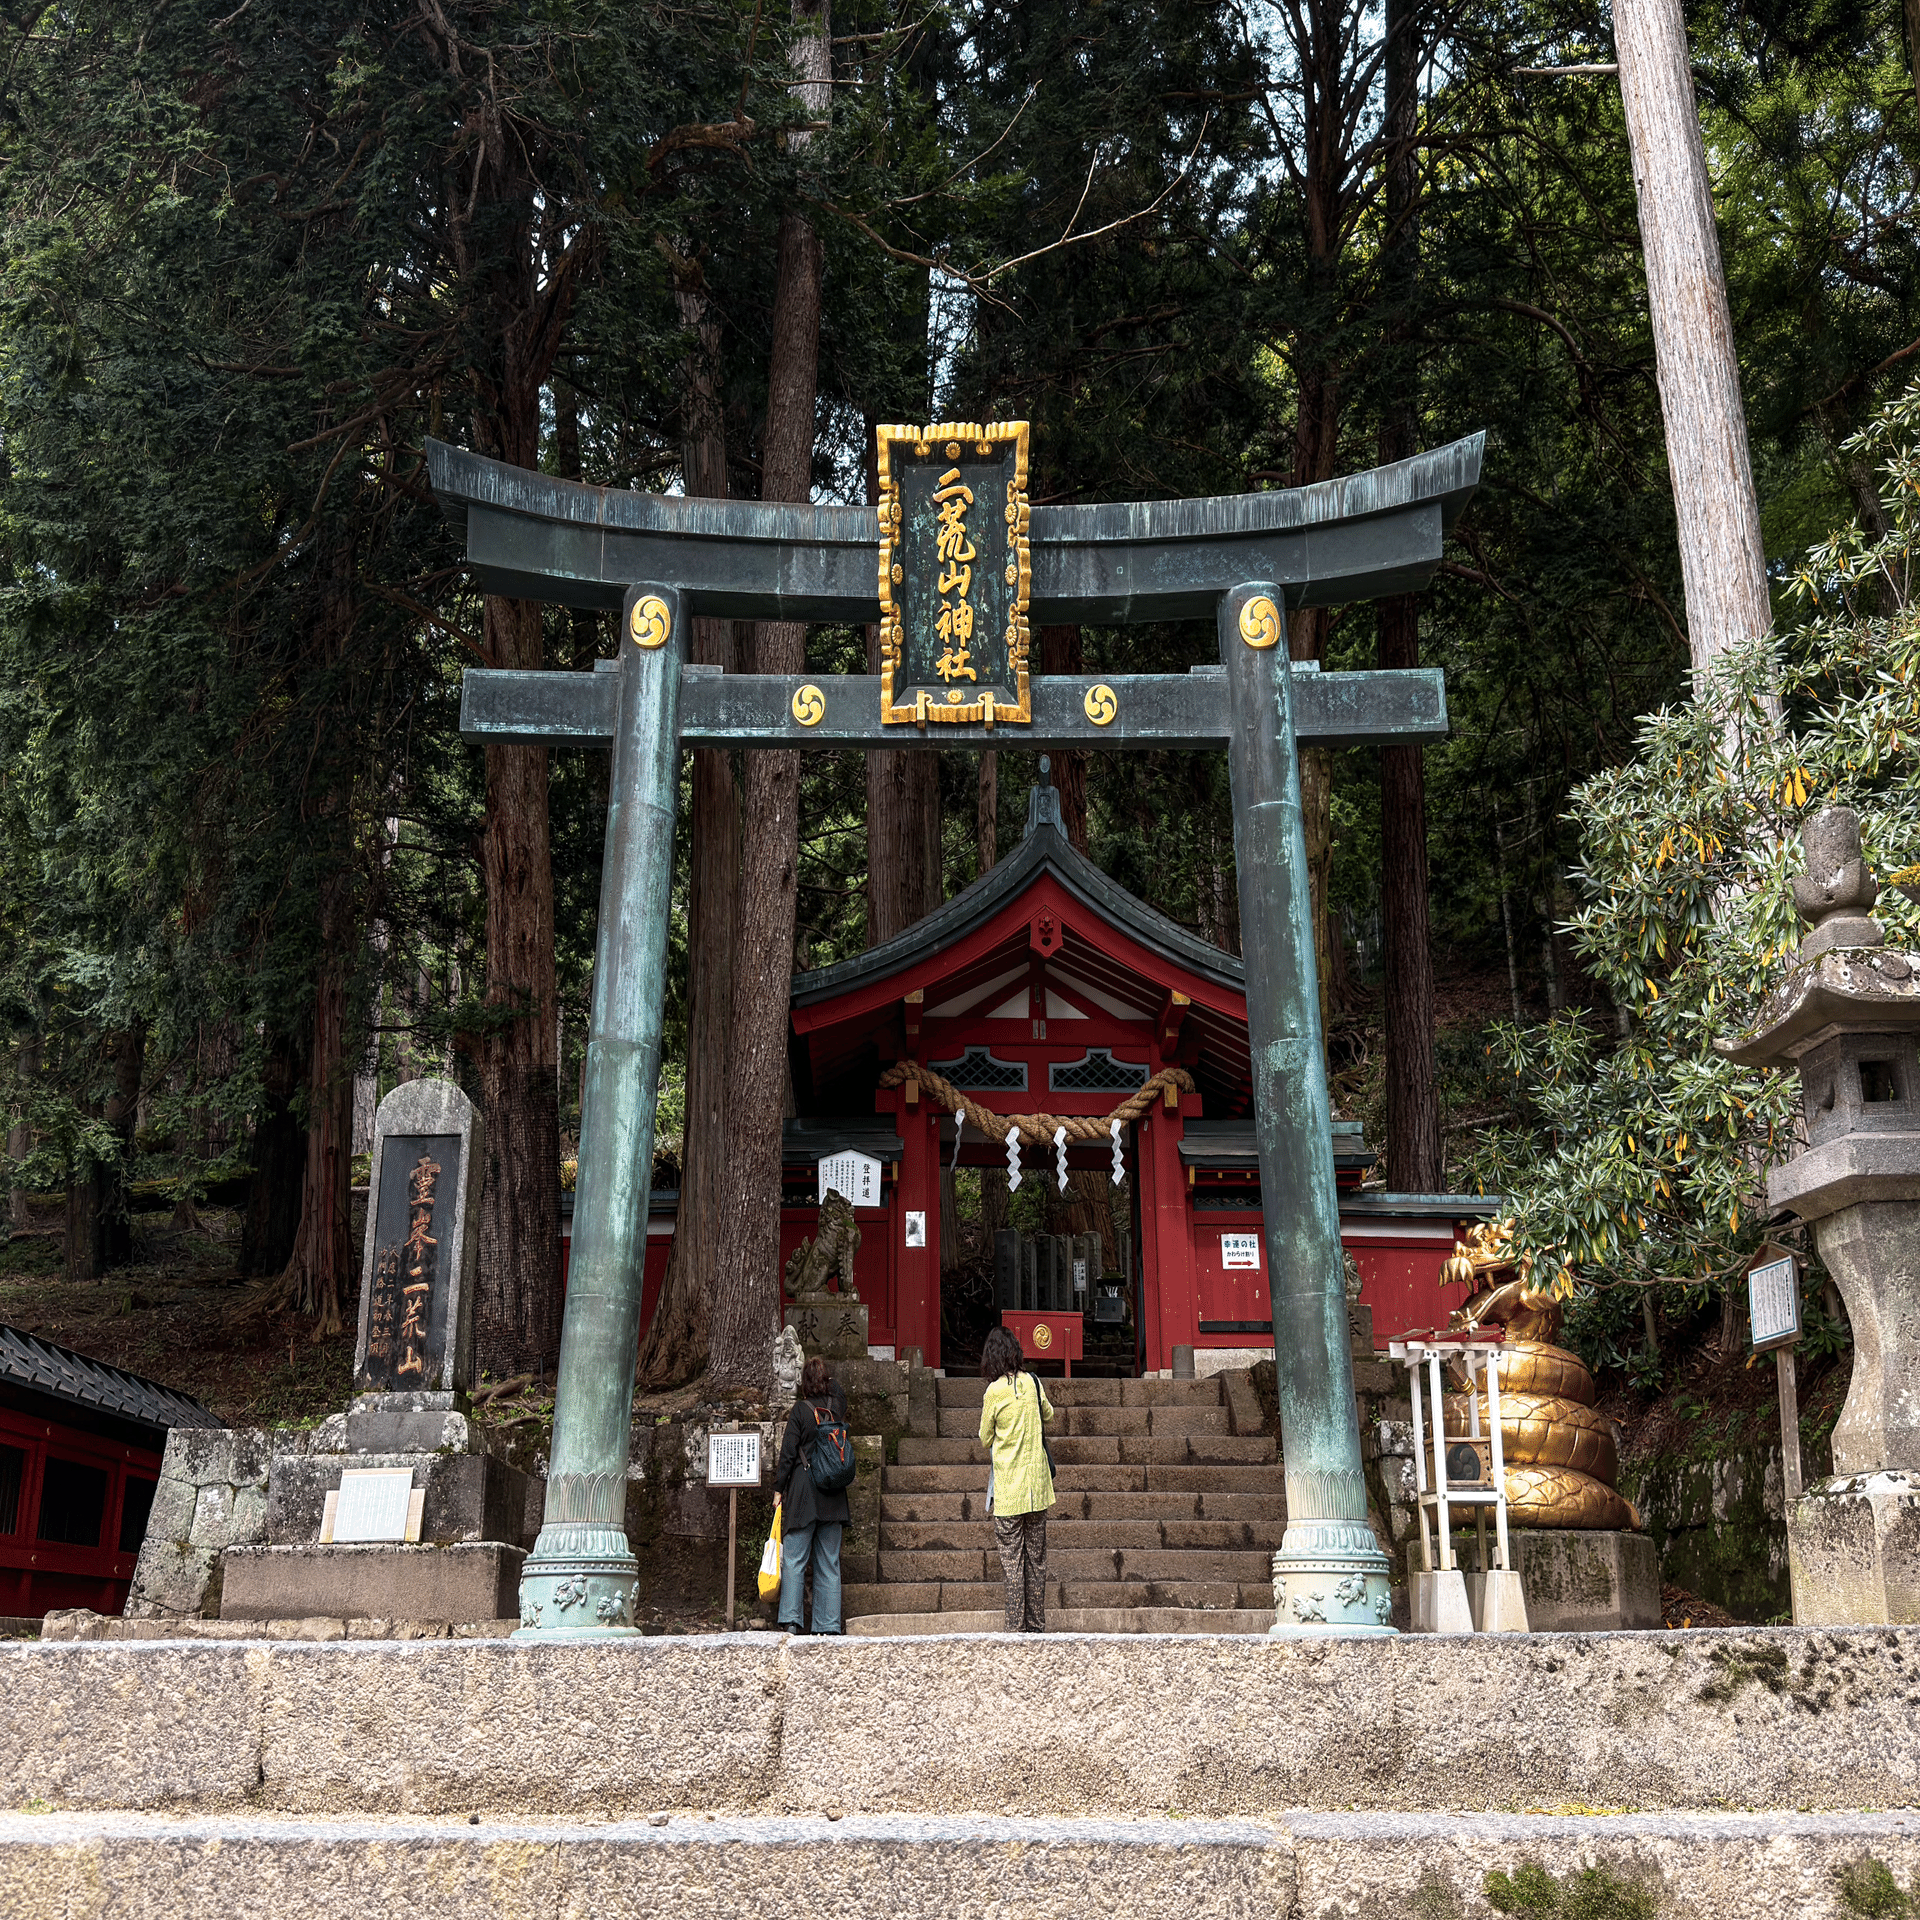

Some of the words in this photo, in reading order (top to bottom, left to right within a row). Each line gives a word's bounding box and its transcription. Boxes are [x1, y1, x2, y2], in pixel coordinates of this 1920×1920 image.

[932, 467, 977, 683] 二荒山神社
[862, 1163, 871, 1199] 登拝道
